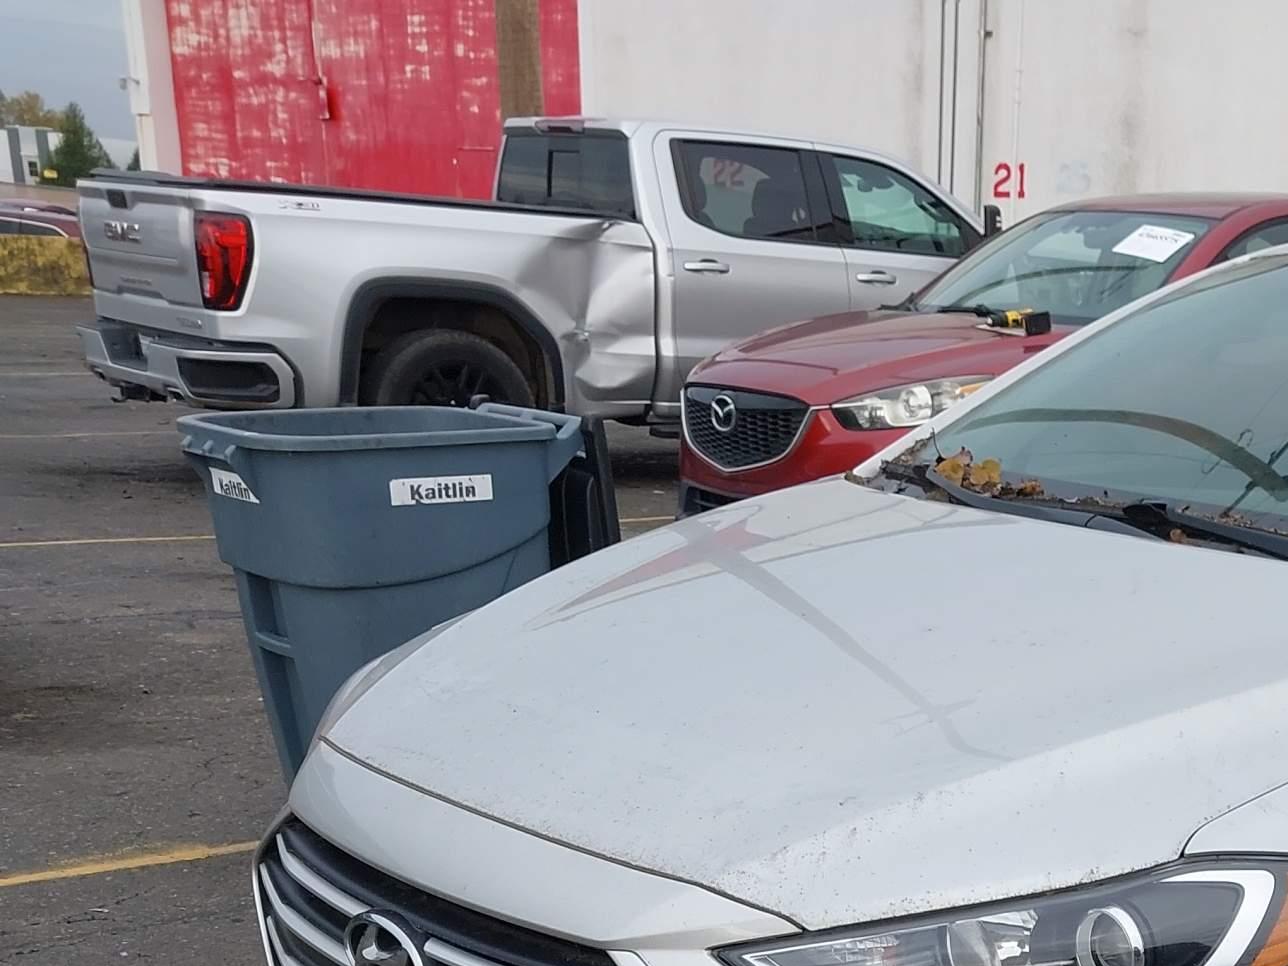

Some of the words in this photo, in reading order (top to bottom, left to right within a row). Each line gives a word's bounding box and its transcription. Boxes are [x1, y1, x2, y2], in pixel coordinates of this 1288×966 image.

[993, 162, 1025, 199] 21
[103, 220, 142, 243] GMC
[218, 477, 251, 500] Kaitlin
[409, 478, 476, 502] Kaitlin
